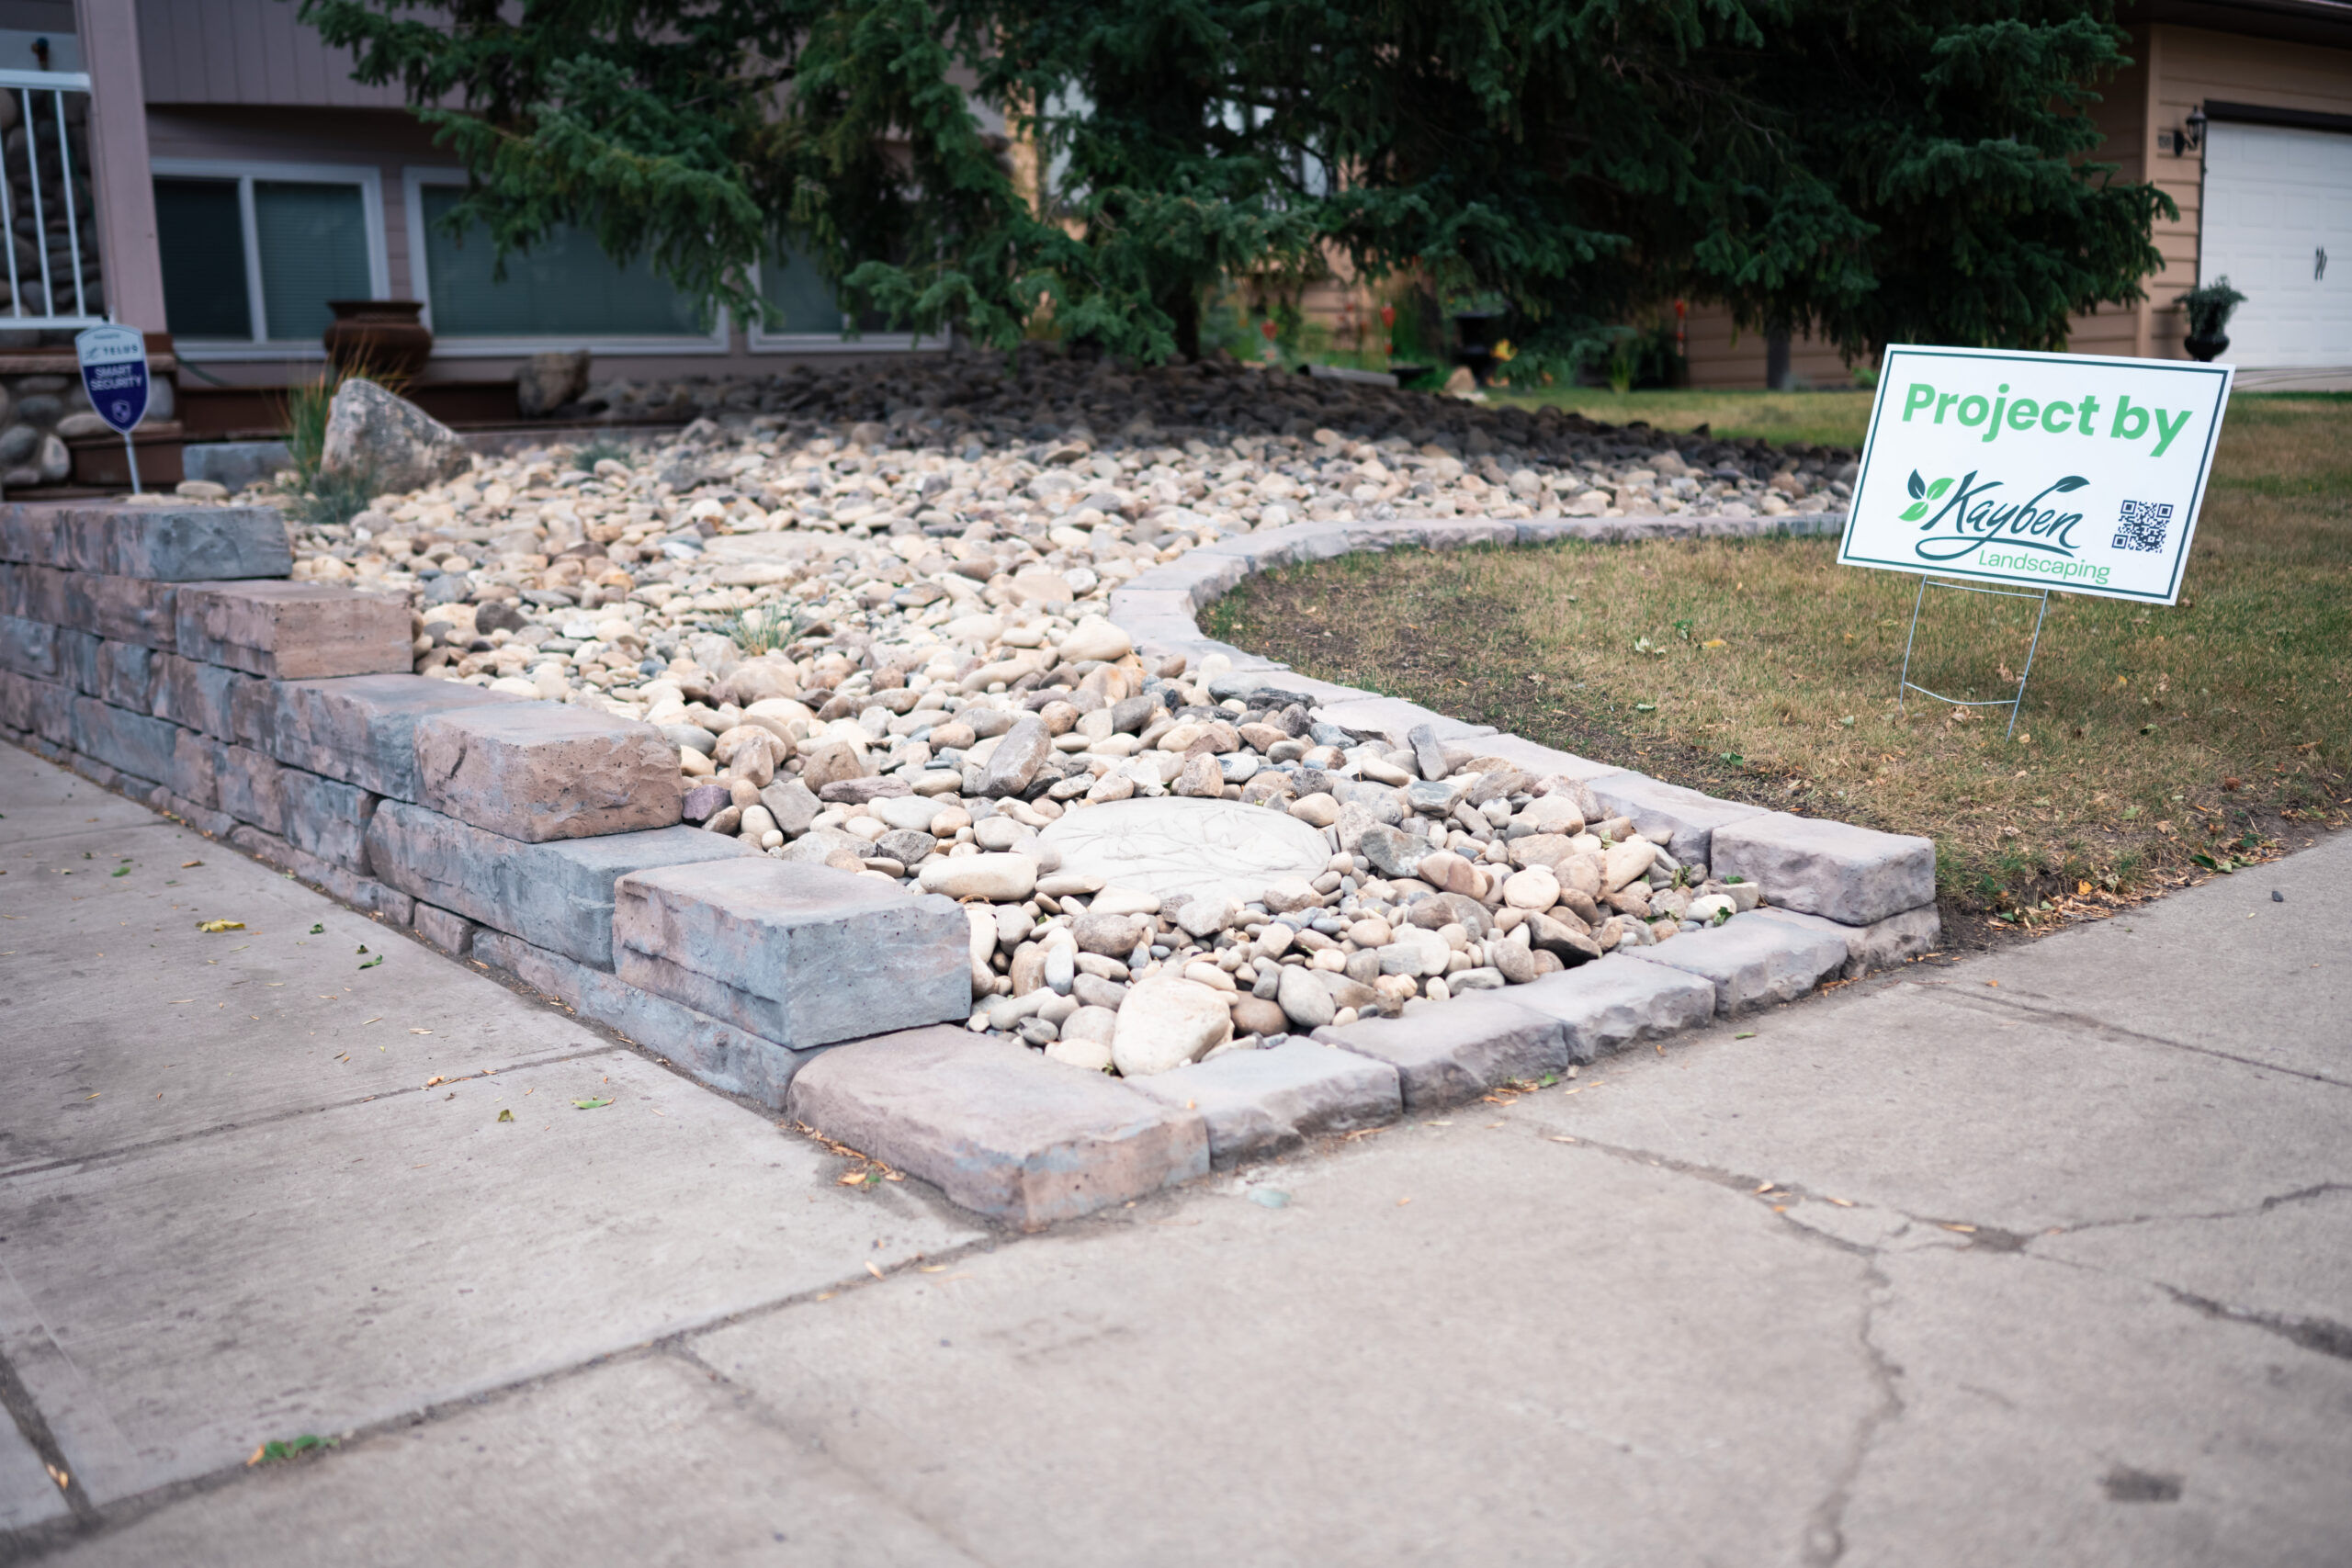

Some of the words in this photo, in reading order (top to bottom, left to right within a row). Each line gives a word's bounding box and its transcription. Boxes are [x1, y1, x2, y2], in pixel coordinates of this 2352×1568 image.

[91, 375, 142, 390] SECURITY
[95, 366, 132, 378] SMART
[1901, 382, 2101, 443] Project
[2109, 395, 2194, 457] by
[1915, 469, 2090, 562] Kayben
[1978, 550, 2110, 585] Landscaping
